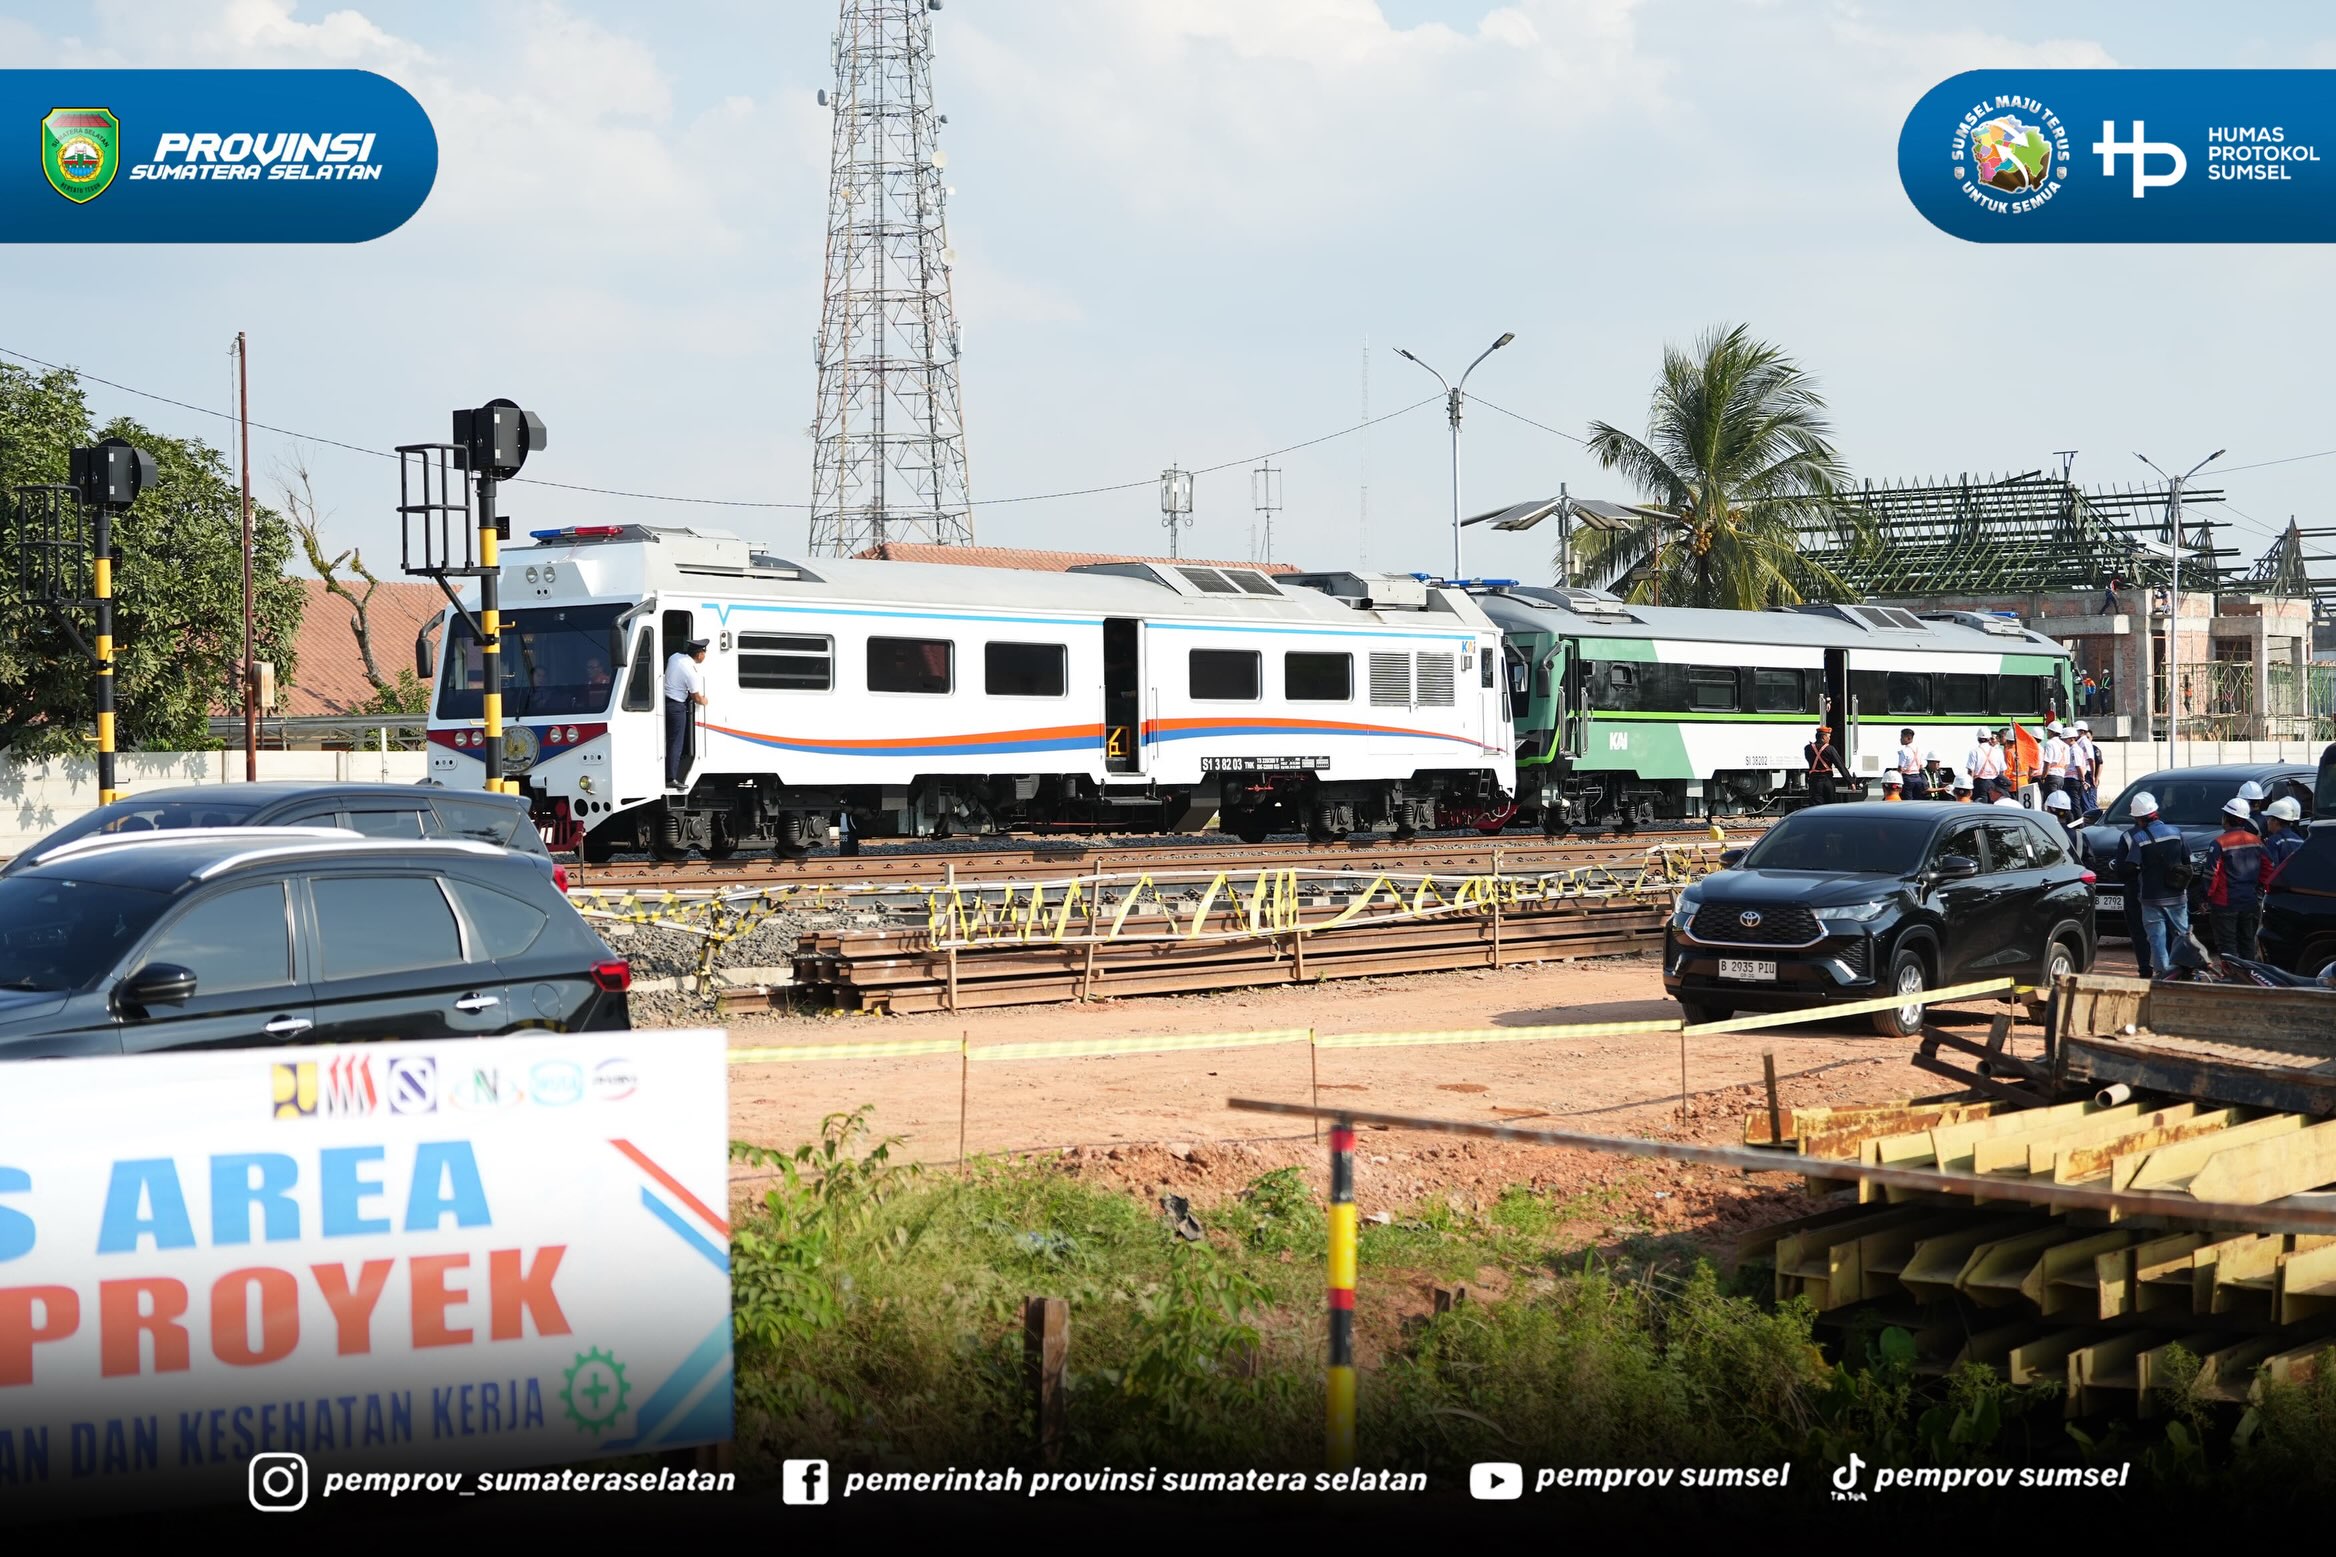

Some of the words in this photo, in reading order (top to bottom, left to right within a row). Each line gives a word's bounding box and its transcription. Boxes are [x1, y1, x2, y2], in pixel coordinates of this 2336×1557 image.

[1609, 731, 1628, 751] KAI
[2023, 793, 2032, 809] 8
[2103, 896, 2122, 906] 2792
[1721, 960, 1727, 971] B
[1731, 961, 1754, 973] 2935
[1758, 962, 1775, 974] PIU
[96, 1137, 494, 1255] AREA
[0, 1243, 573, 1387] PROYEK
[70, 1414, 158, 1480] DAN
[180, 1389, 412, 1472] KESEHATAN
[432, 1377, 545, 1440] KERJA
